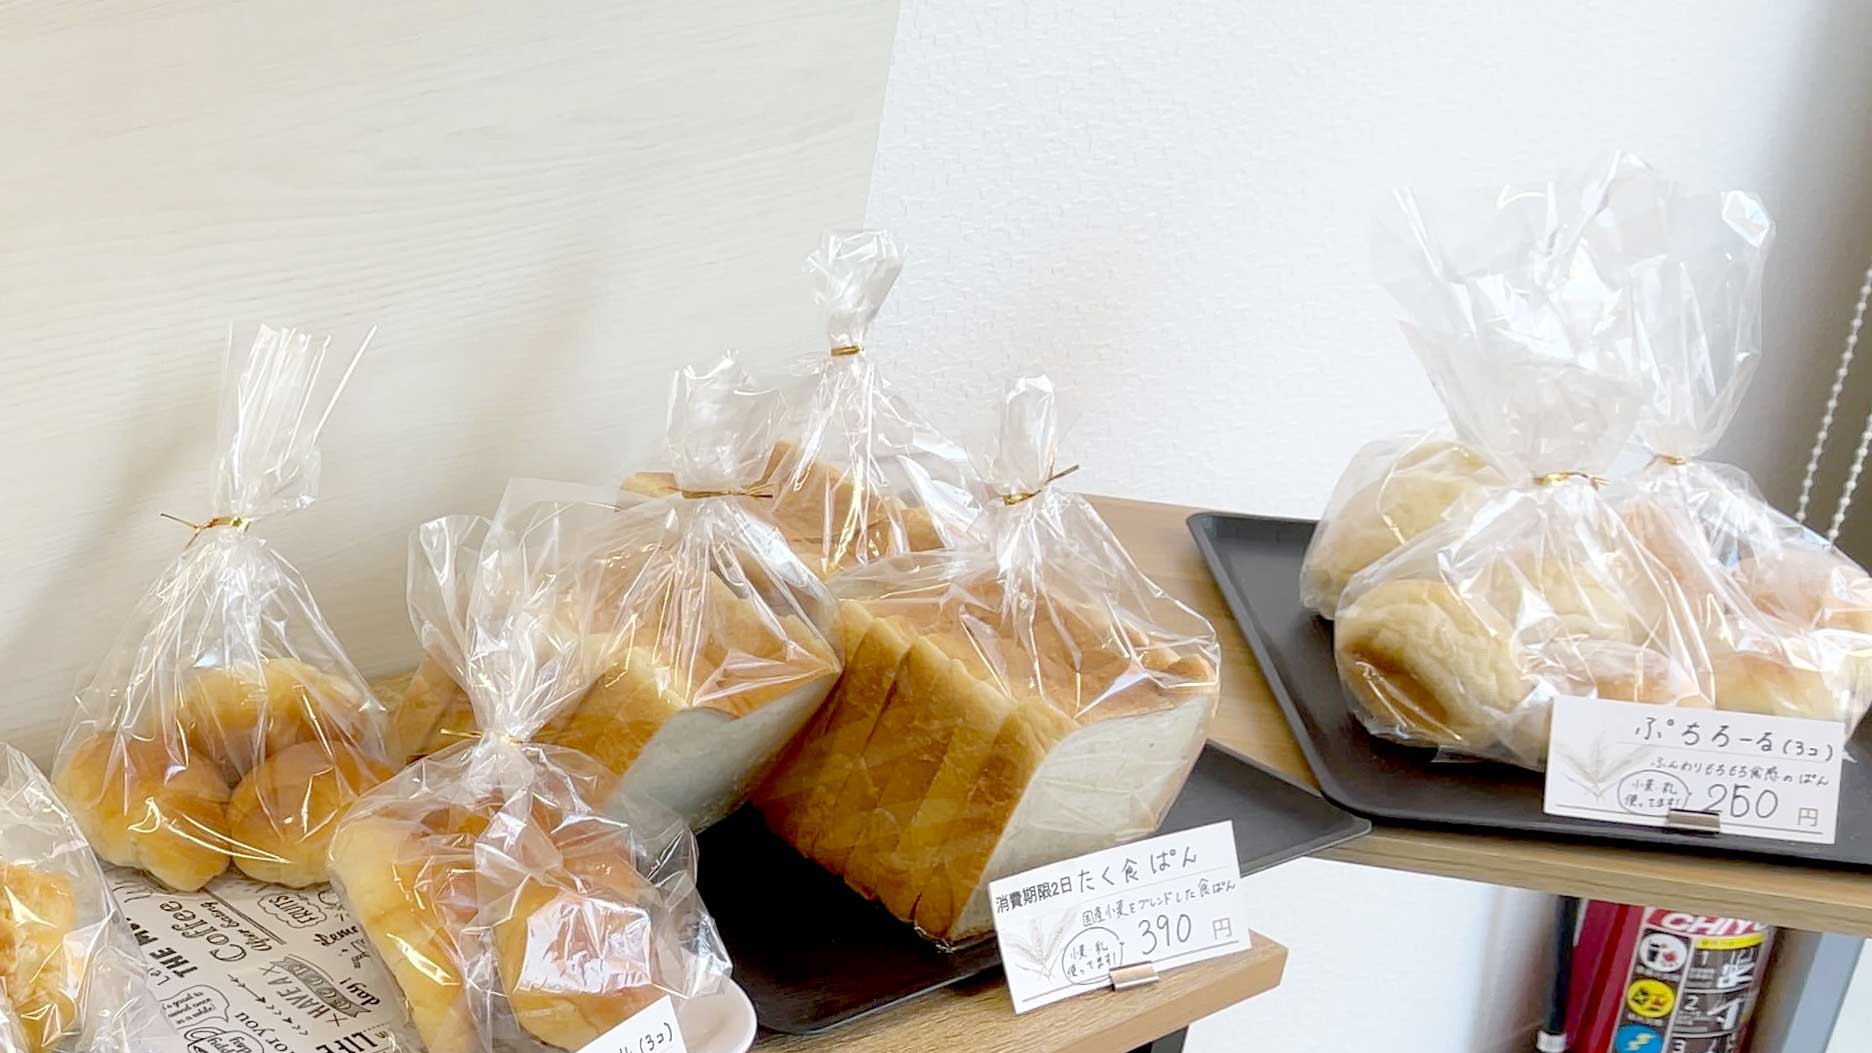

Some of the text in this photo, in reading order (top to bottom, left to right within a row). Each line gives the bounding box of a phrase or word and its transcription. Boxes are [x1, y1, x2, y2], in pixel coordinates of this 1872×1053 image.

[1798, 807, 1819, 828] 円
[269, 895, 319, 925] FRUITS
[995, 876, 1073, 914] 消費期限2日
[159, 901, 247, 962] Coffee
[1138, 913, 1232, 956] 390 円
[149, 947, 198, 979] THE
[276, 985, 330, 1019] HAVE
[234, 1011, 276, 1037] you
